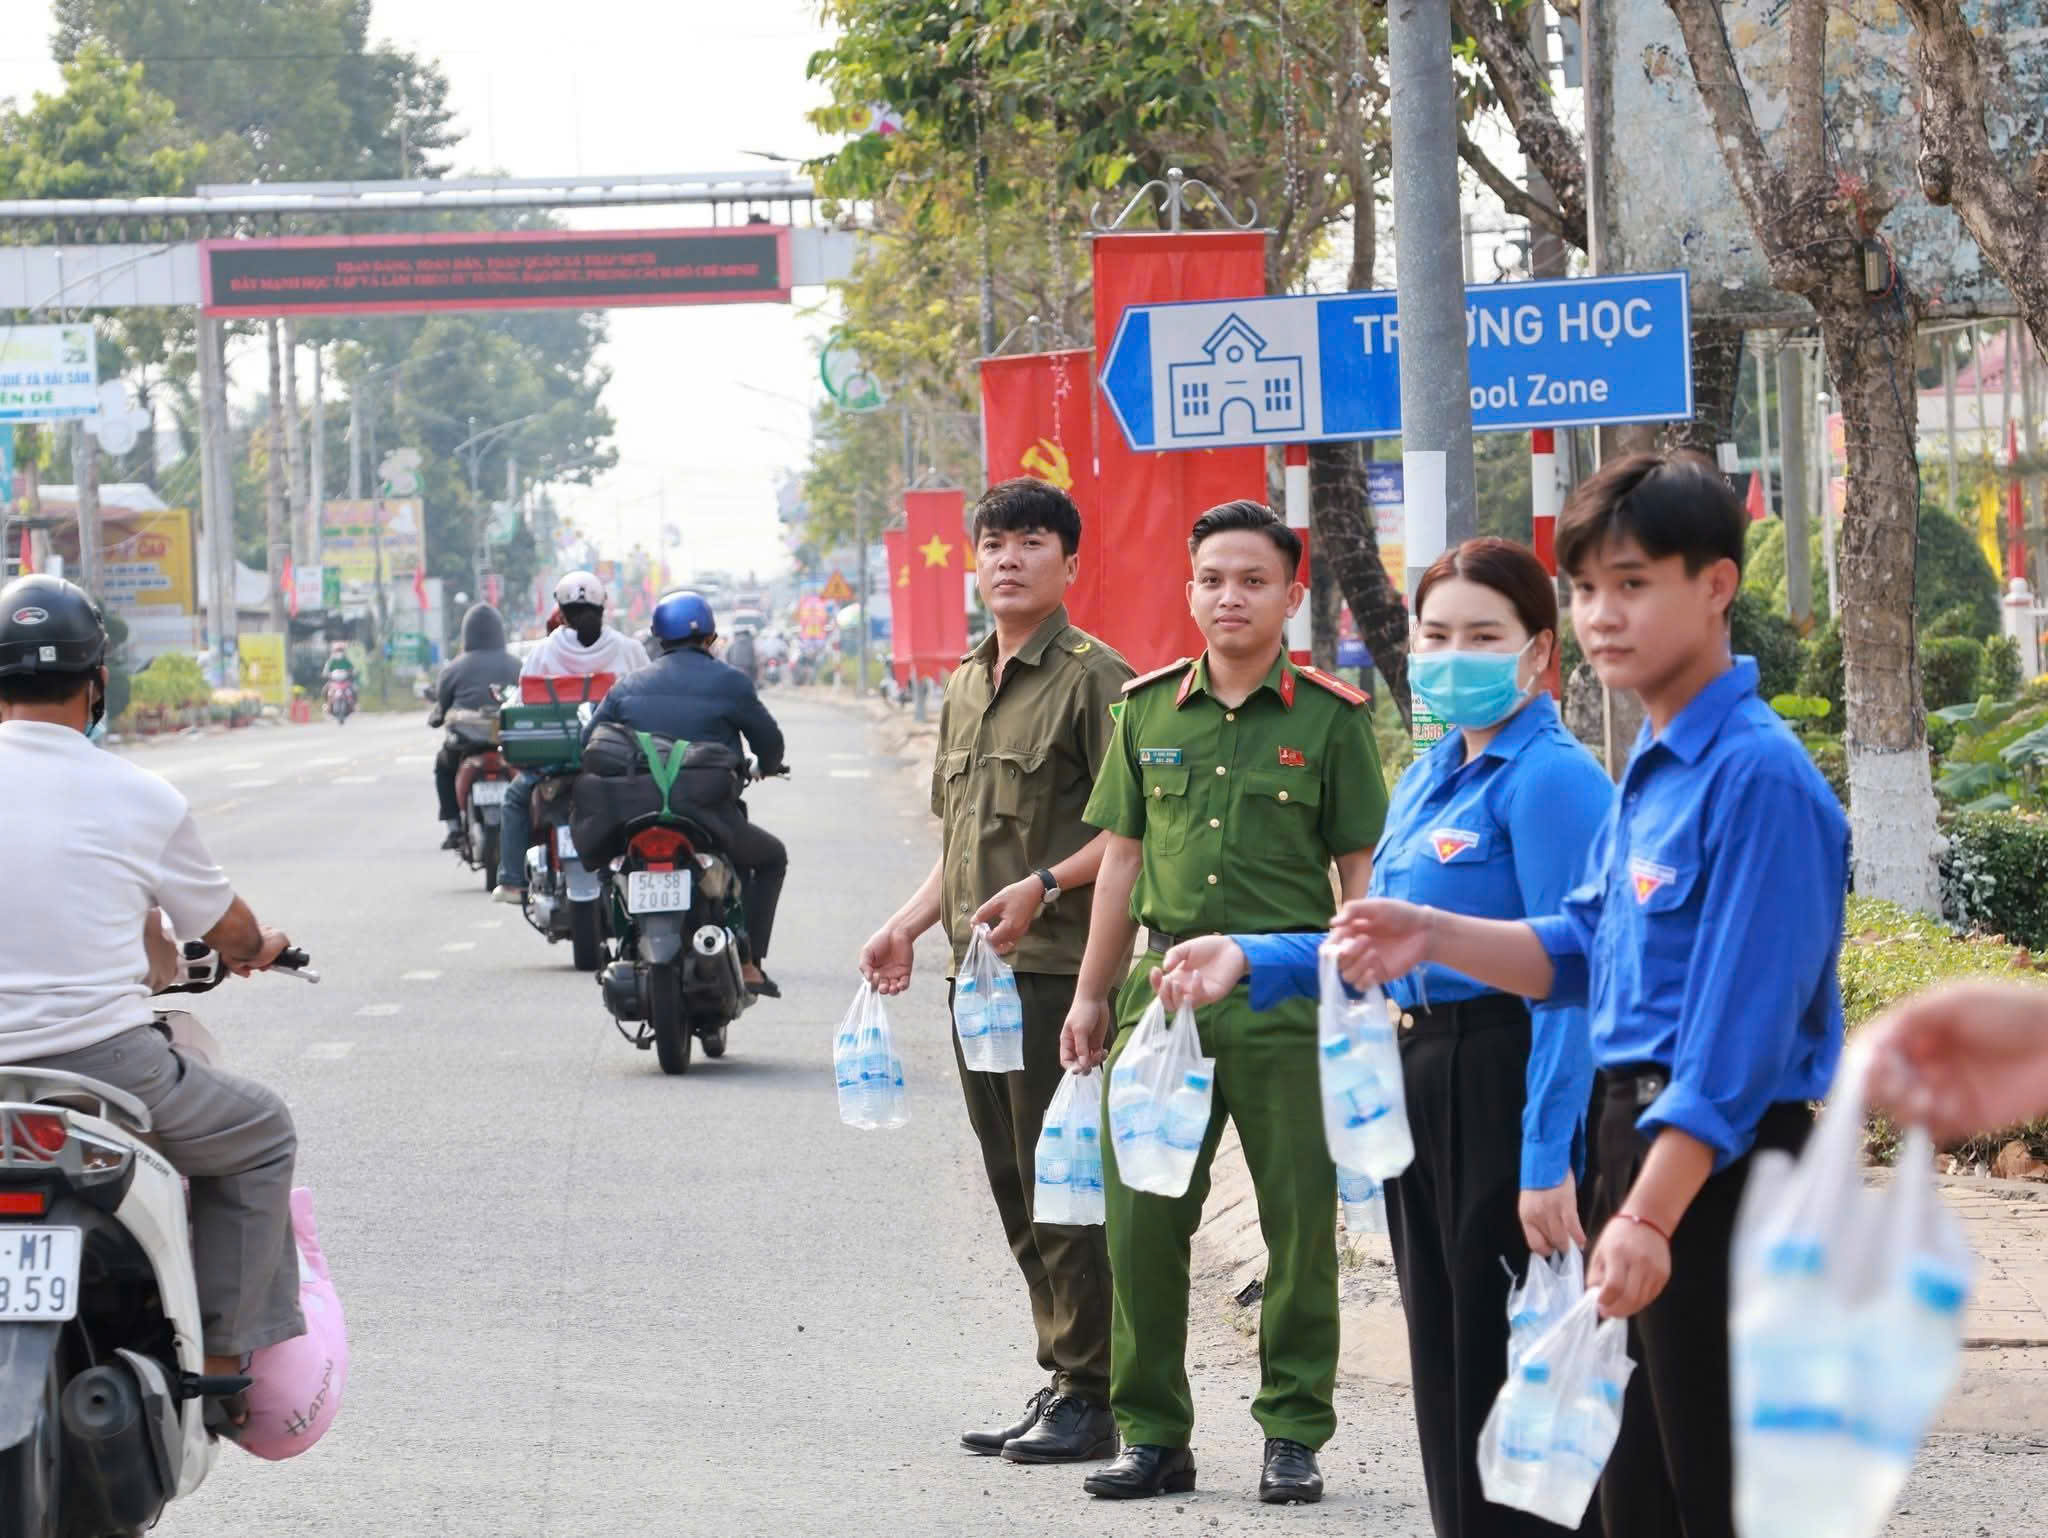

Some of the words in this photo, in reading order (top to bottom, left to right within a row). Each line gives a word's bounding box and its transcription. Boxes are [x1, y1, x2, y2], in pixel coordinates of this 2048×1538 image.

[1353, 304, 1544, 355] TRỜNG
[1559, 297, 1653, 347] HỌC
[1527, 373, 1609, 406] Zone
[638, 892, 681, 909] 2003
